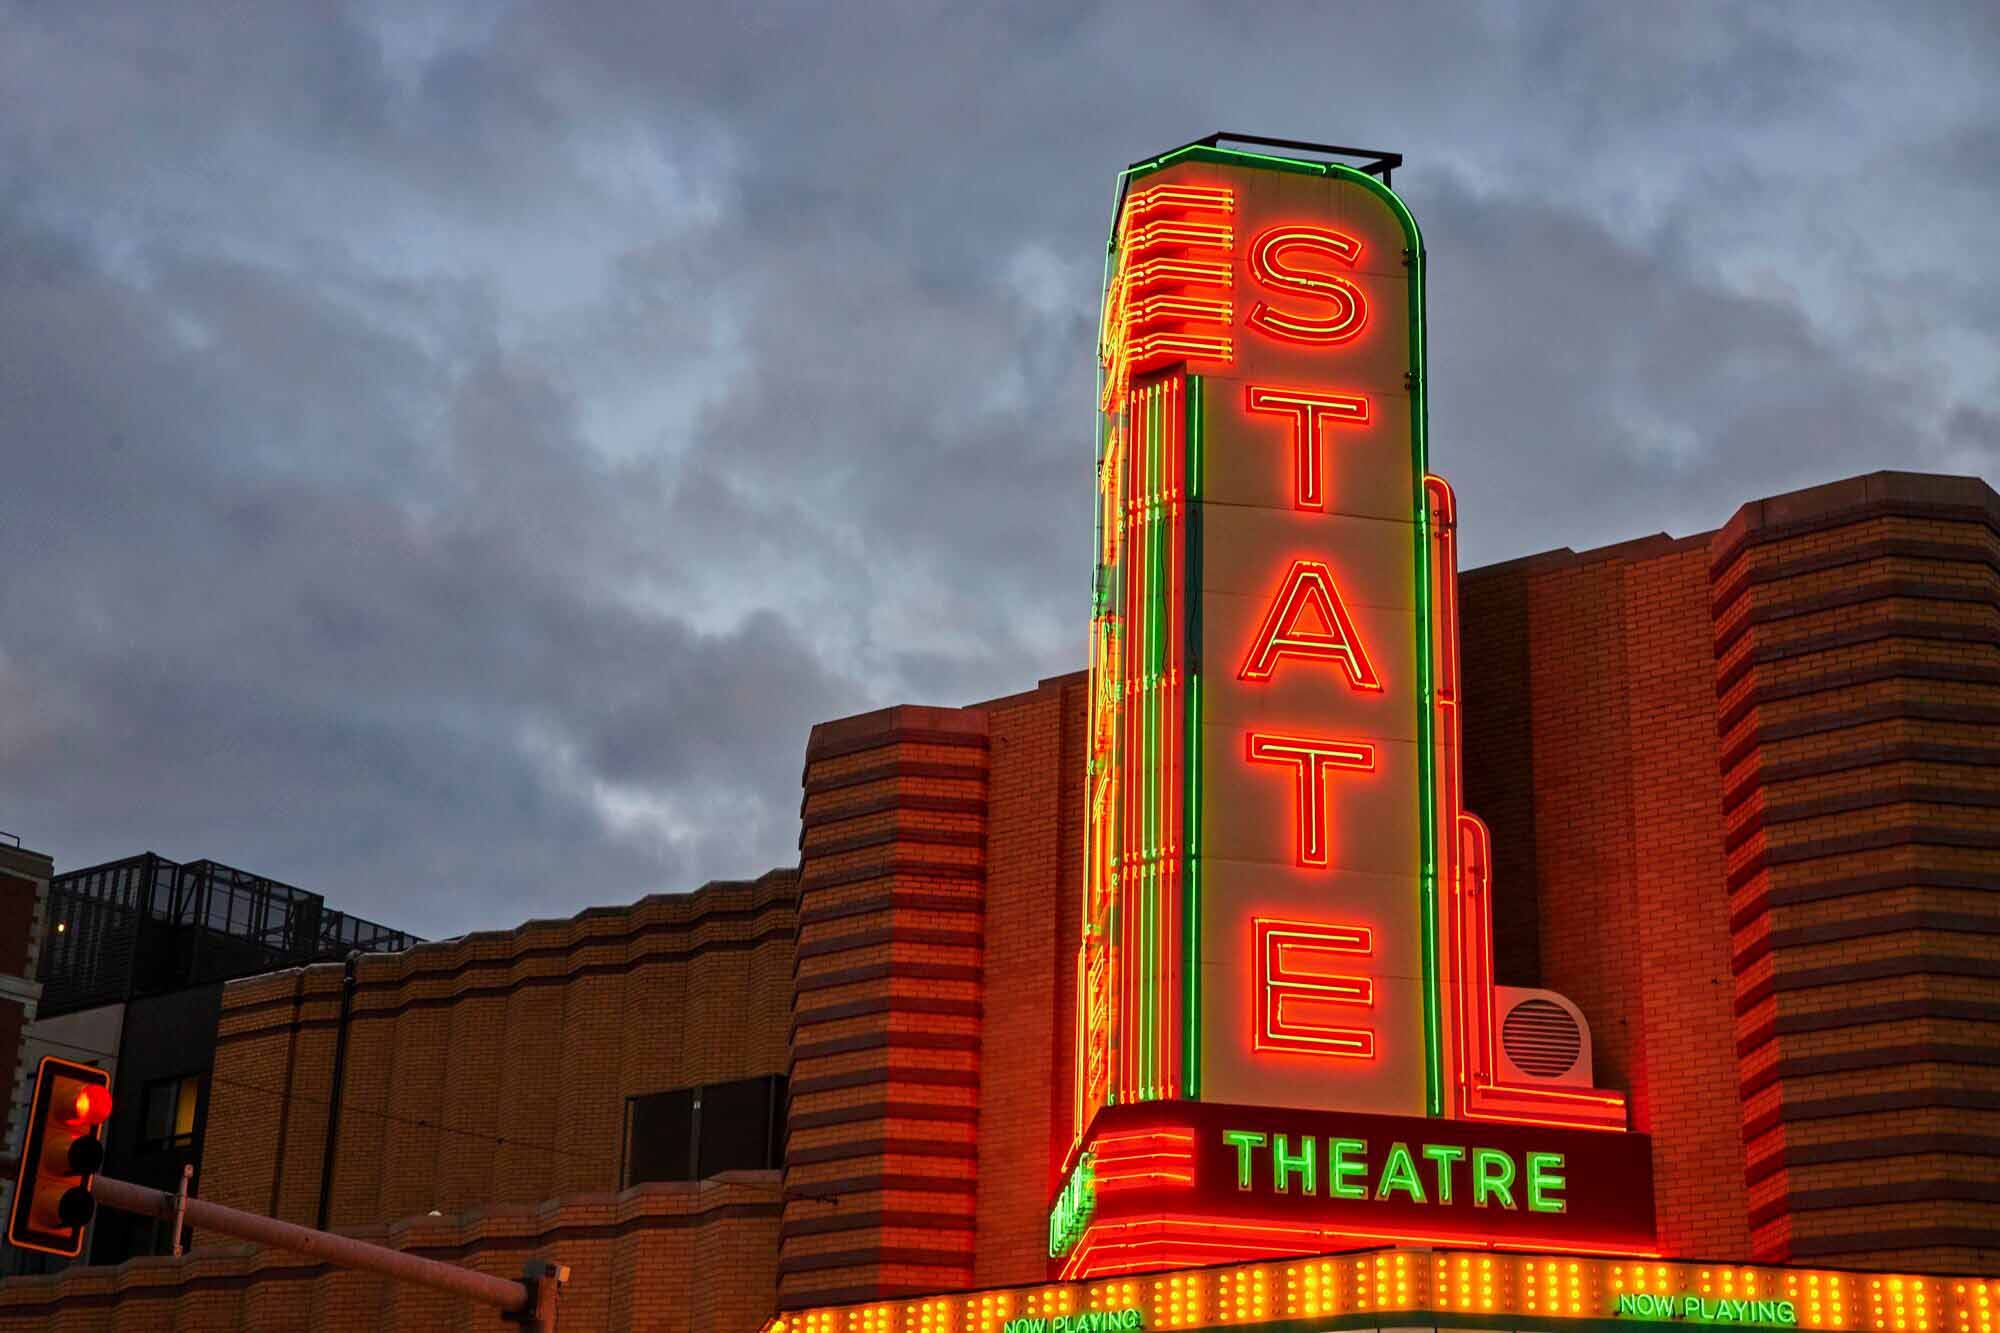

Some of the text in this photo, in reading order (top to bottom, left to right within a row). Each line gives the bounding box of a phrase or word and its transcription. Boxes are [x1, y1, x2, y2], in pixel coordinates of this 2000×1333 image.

[1238, 225, 1384, 1060] STATE
[1223, 1129, 1567, 1214] THEATRE
[1004, 1308, 1139, 1333] NOW PLAYING
[1620, 1294, 1797, 1323] NOW PLAYING
